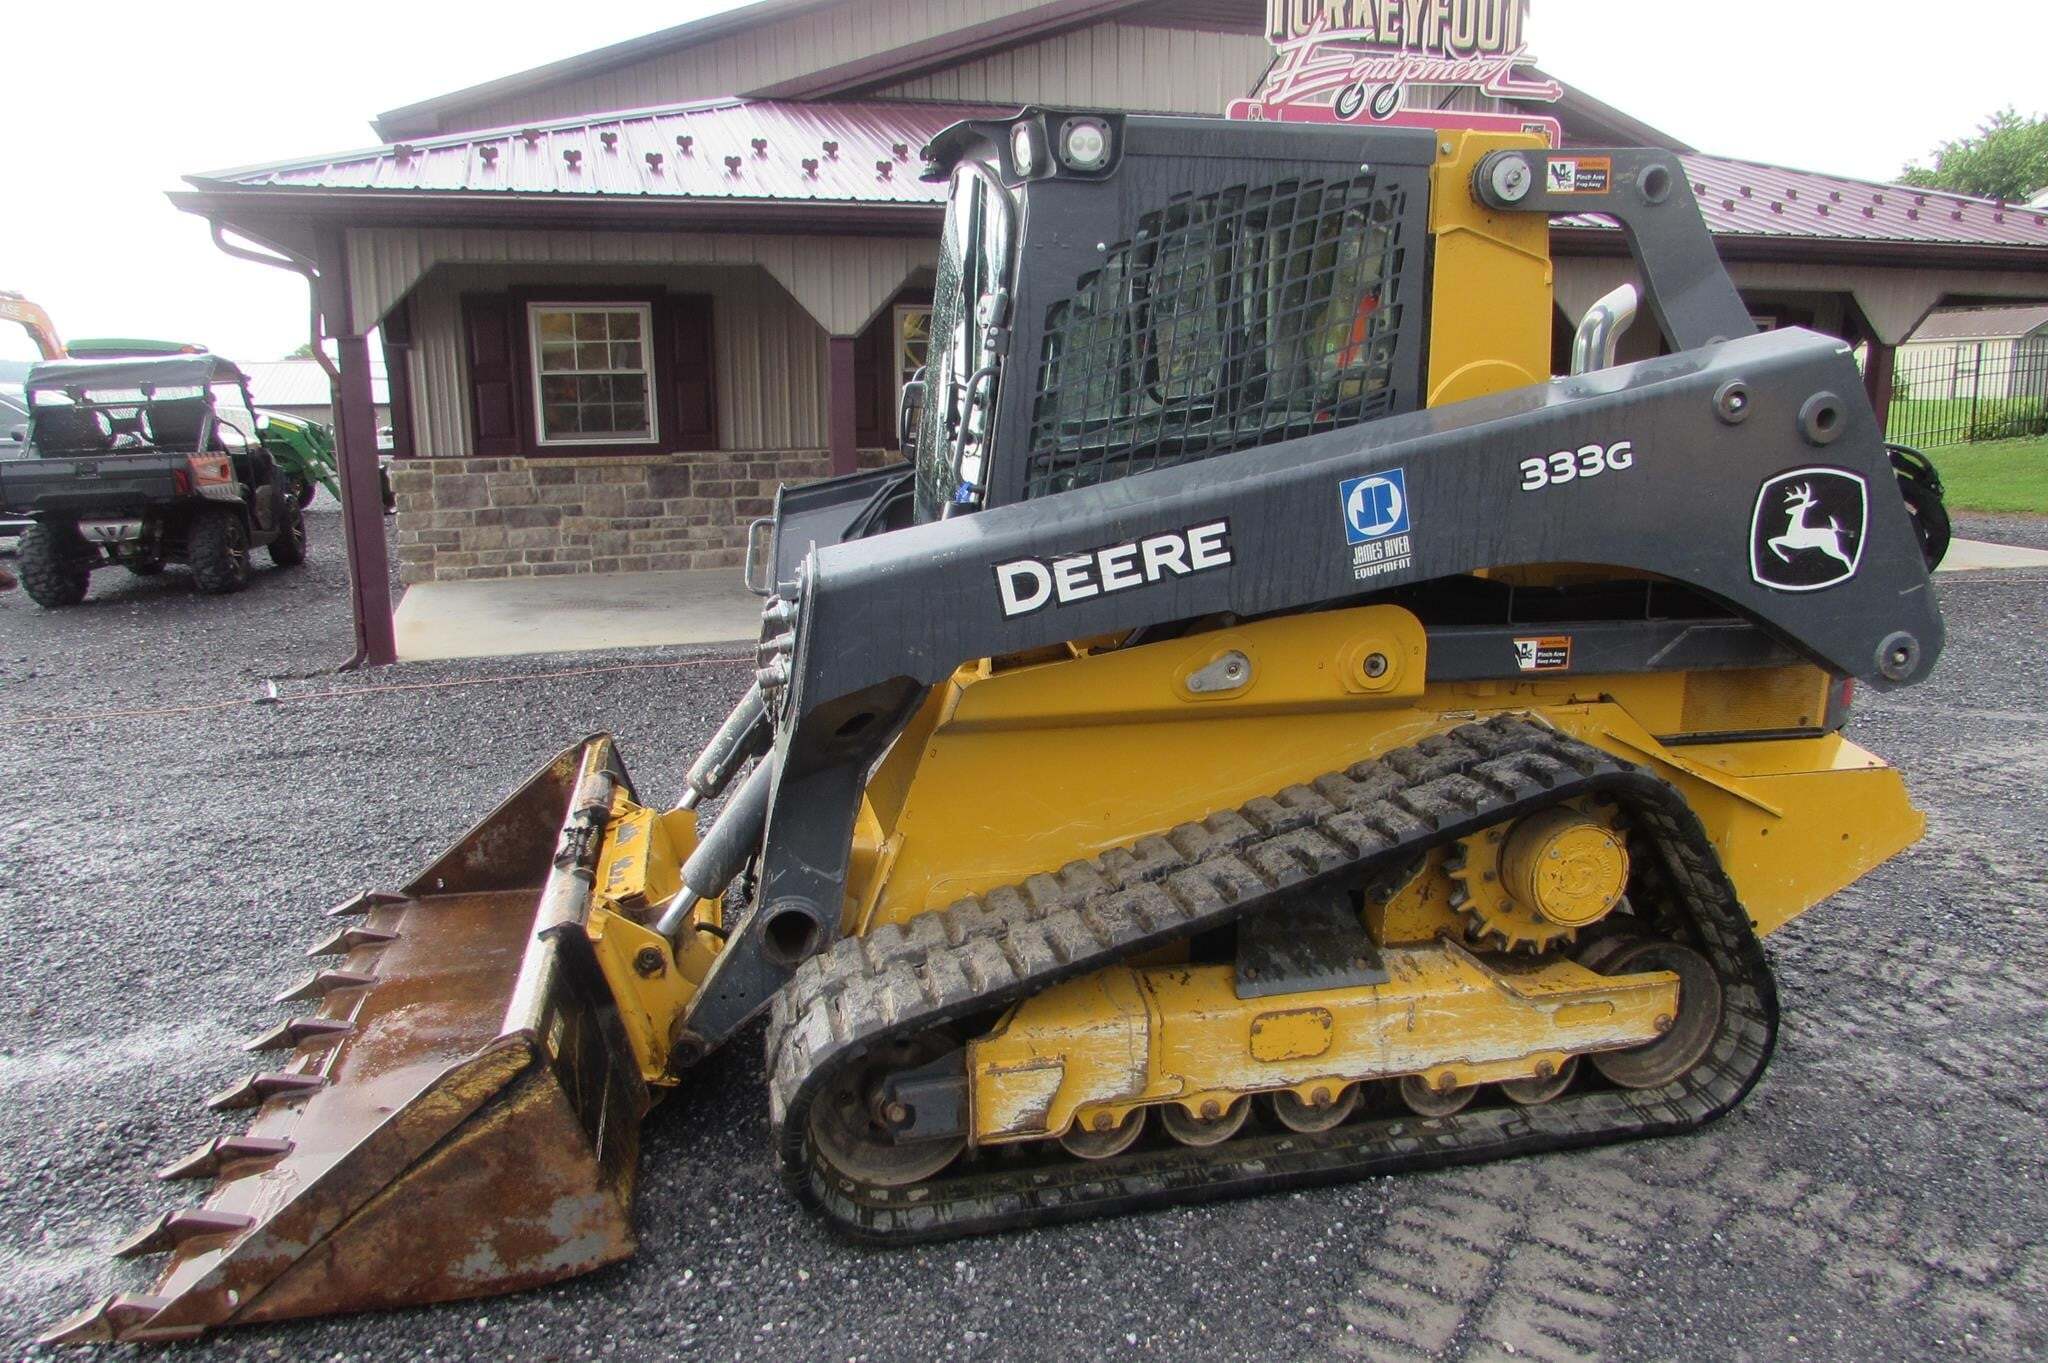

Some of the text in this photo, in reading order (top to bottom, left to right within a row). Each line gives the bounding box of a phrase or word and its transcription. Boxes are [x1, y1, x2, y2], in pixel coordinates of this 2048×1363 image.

[1265, 14, 1561, 105] Equipment
[1520, 441, 1633, 491] 333G
[997, 522, 1232, 616] DEERE
[1353, 536, 1410, 565] JAMES RIVER
[1354, 557, 1411, 579] EQUIPMENT
